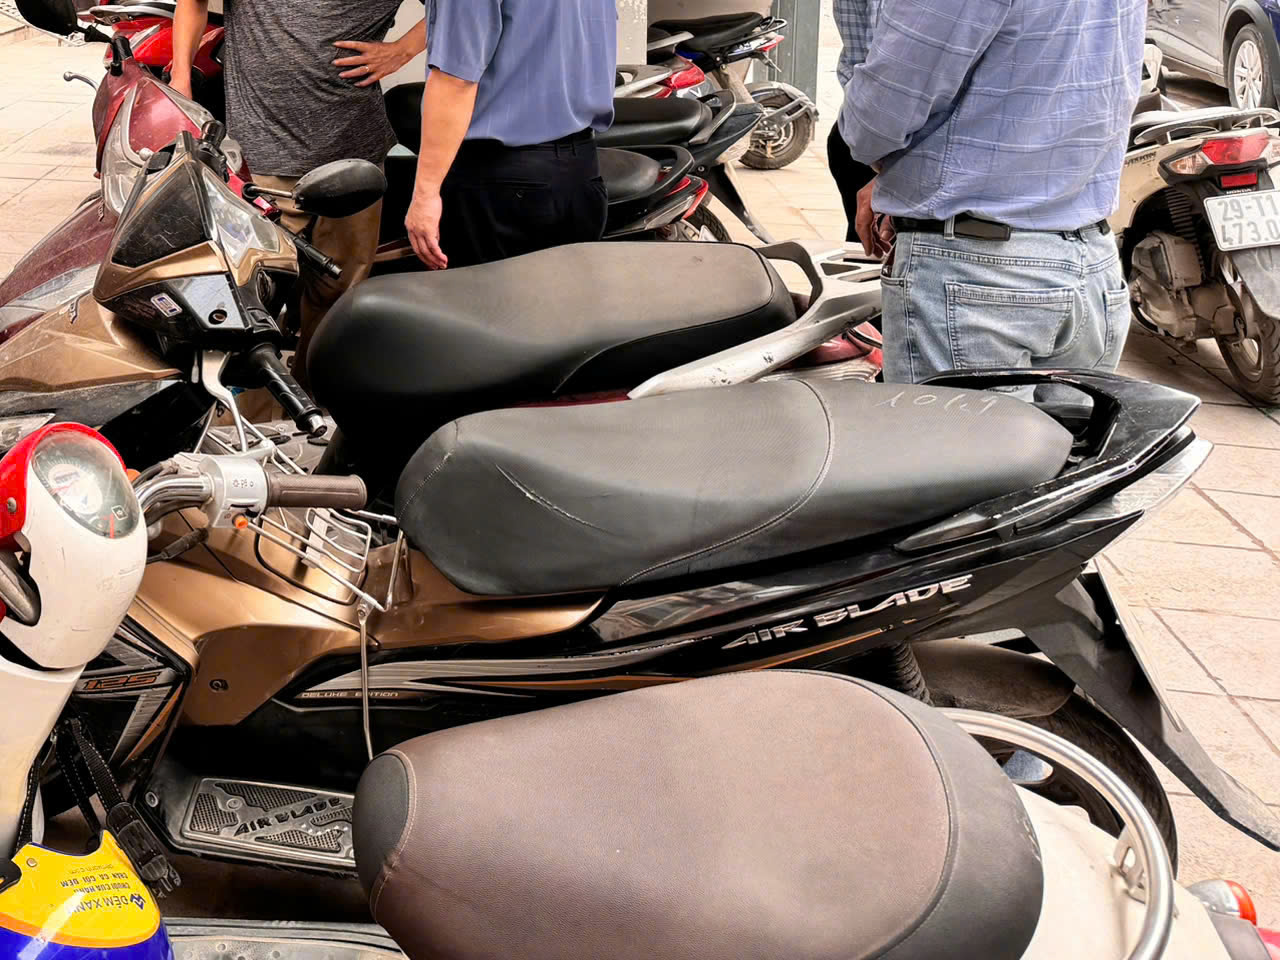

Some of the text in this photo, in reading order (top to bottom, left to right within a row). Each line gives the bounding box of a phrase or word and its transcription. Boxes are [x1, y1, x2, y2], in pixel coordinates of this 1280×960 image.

[721, 573, 974, 650] AIR BLADE
[82, 671, 163, 691] 125
[301, 691, 348, 699] DELUXE
[233, 797, 342, 837] AIR BLADE
